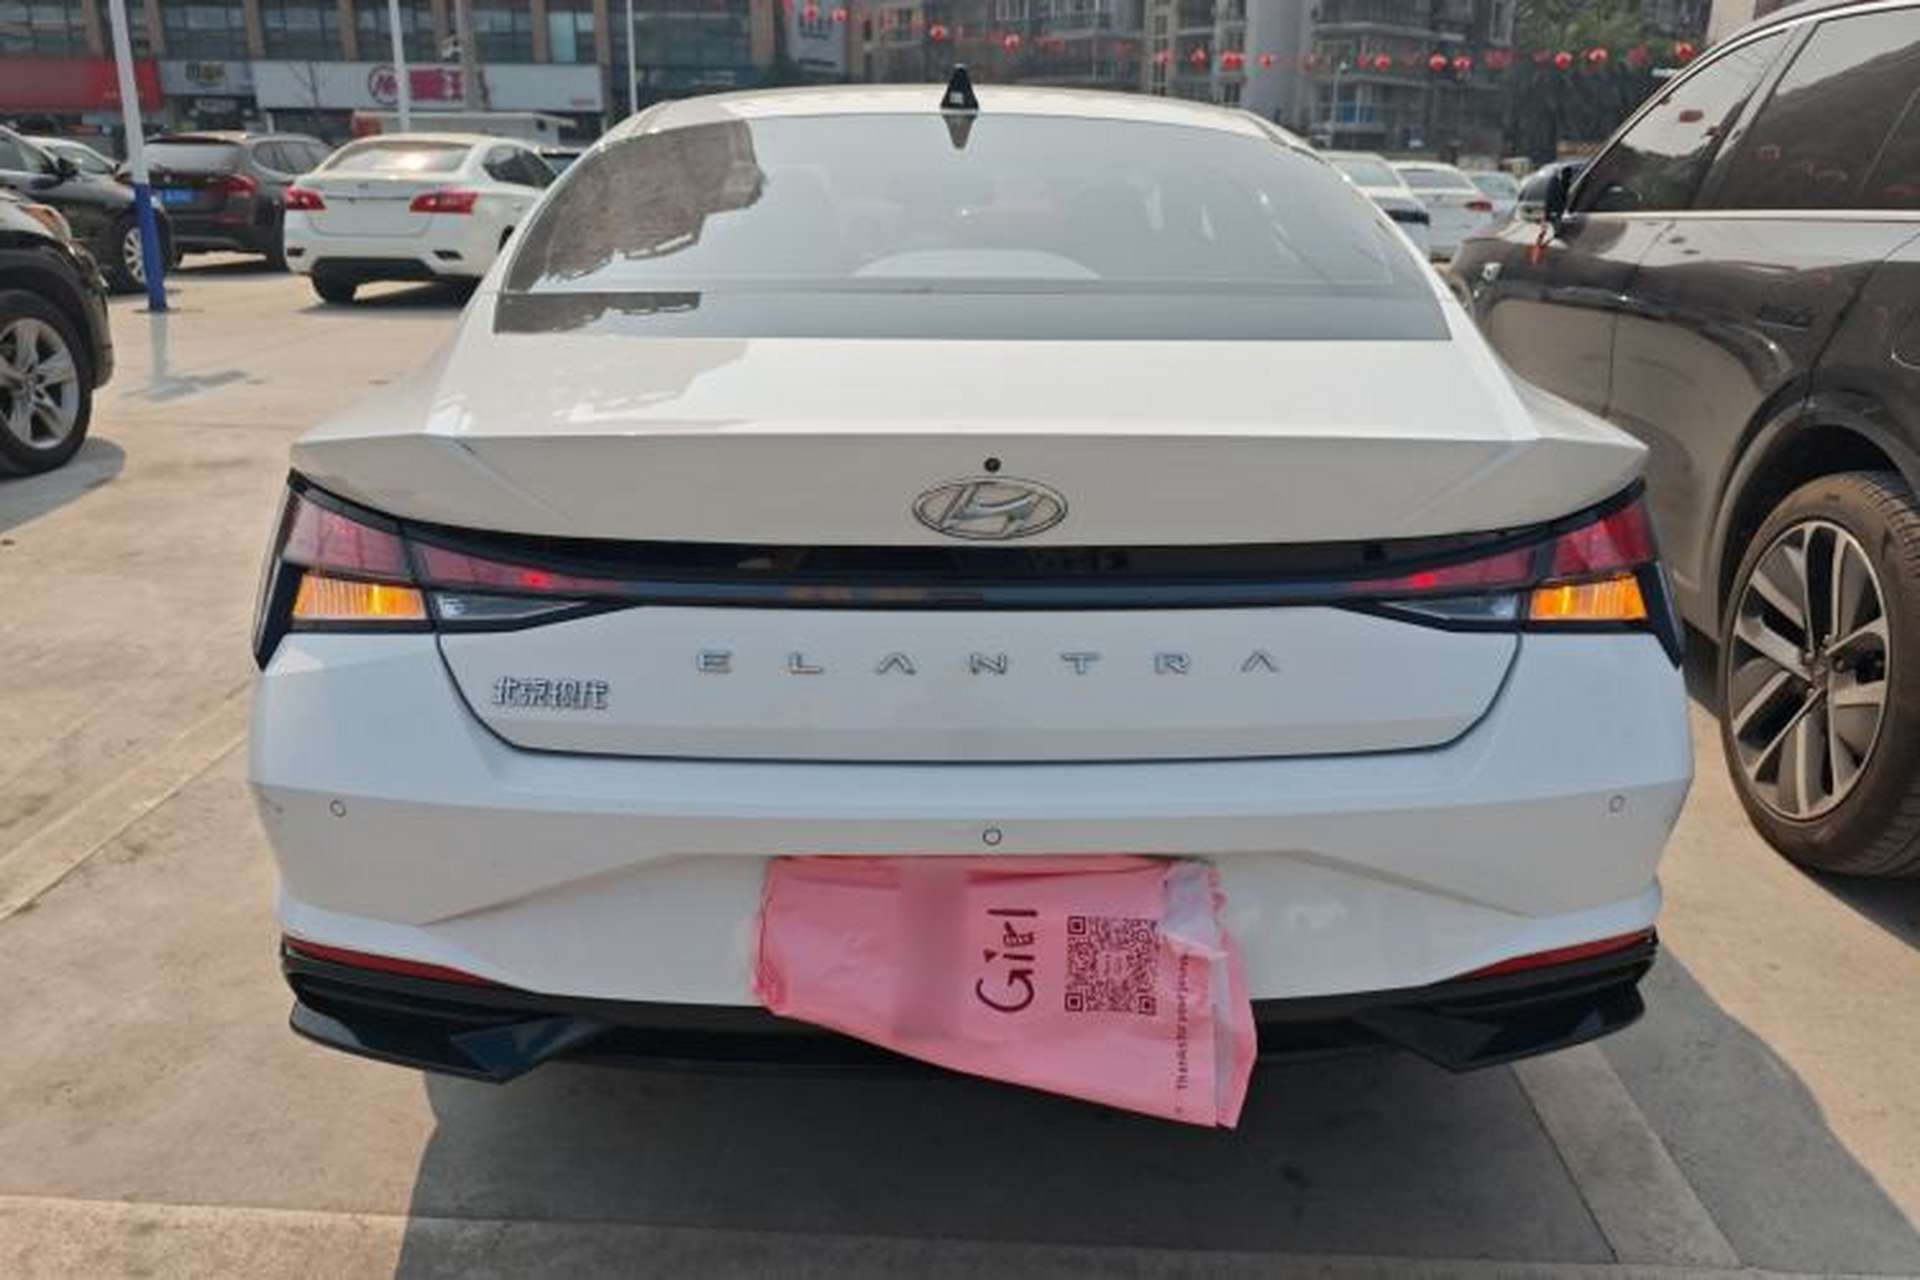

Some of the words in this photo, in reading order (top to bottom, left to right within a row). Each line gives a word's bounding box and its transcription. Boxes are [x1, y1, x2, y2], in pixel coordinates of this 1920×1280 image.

[696, 650, 1279, 675] ELANTRA
[492, 676, 610, 710] 北京现代
[975, 909, 1038, 1013] Girl
